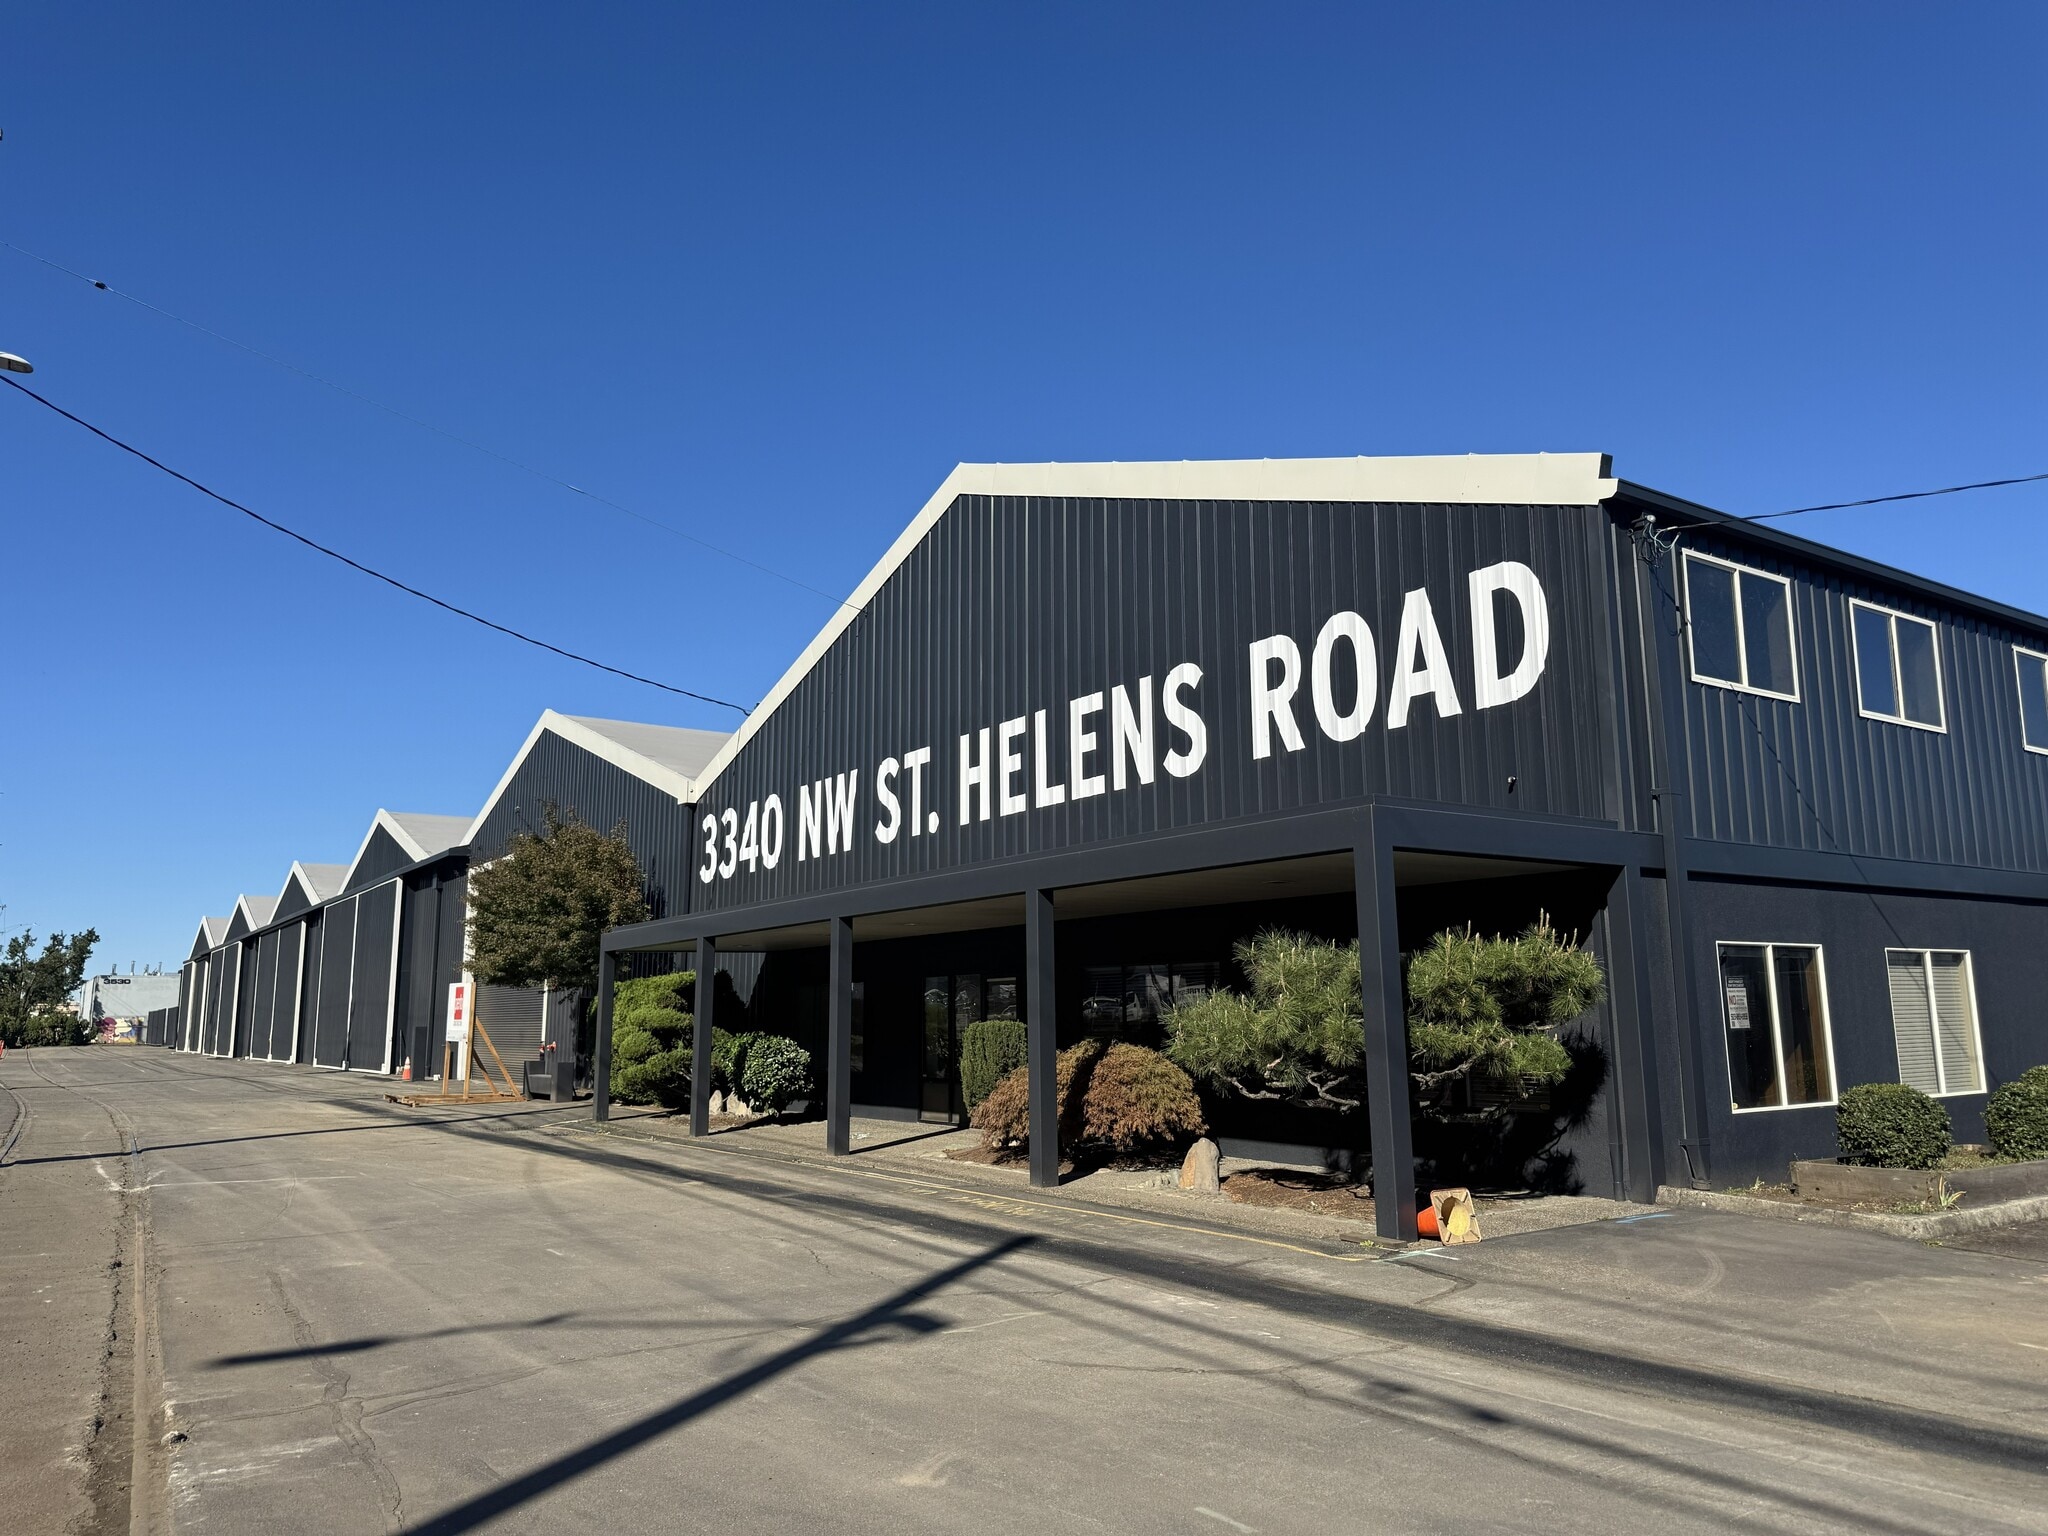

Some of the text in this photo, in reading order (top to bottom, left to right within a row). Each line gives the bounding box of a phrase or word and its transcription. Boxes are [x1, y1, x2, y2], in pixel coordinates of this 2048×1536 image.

[699, 560, 1550, 884] 3340 NW ST. HELENS ROAD
